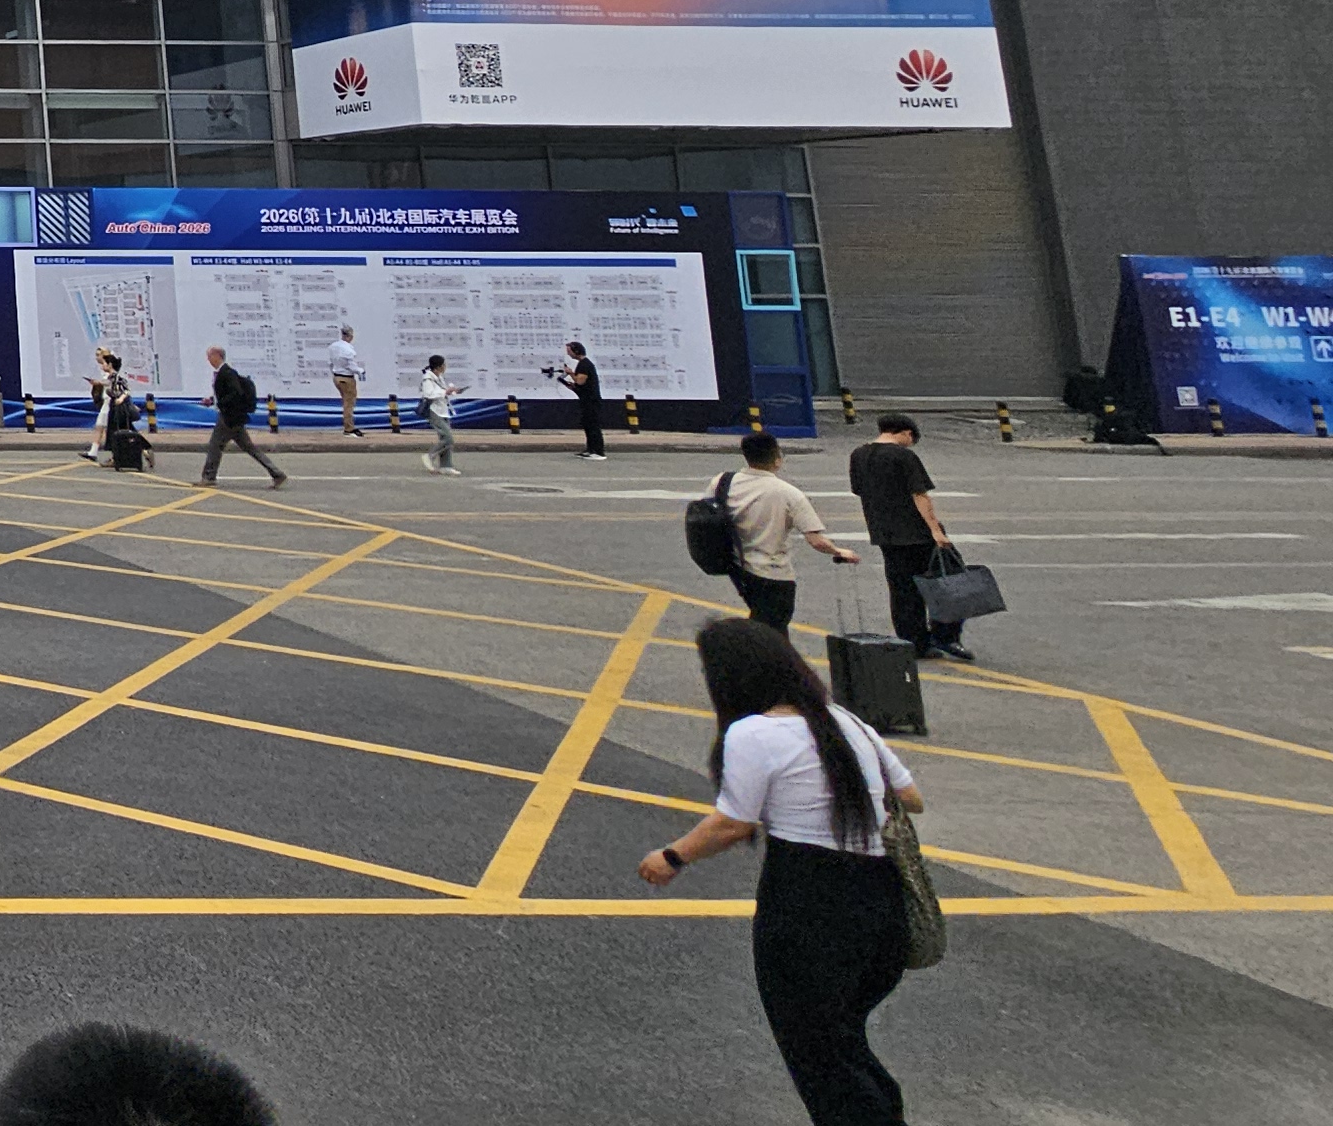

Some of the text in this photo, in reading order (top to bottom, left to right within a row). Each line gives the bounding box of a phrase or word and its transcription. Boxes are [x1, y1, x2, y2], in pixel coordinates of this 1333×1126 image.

[335, 100, 372, 116] HUAWEI
[898, 95, 960, 109] HUAWEI
[106, 220, 211, 234] Auto China 2026
[260, 225, 519, 234] 2026 BEIJING INTERNATIONAL AUTOMOTIVE EXHBITION
[1169, 306, 1333, 327] E1-E4 W1-W
